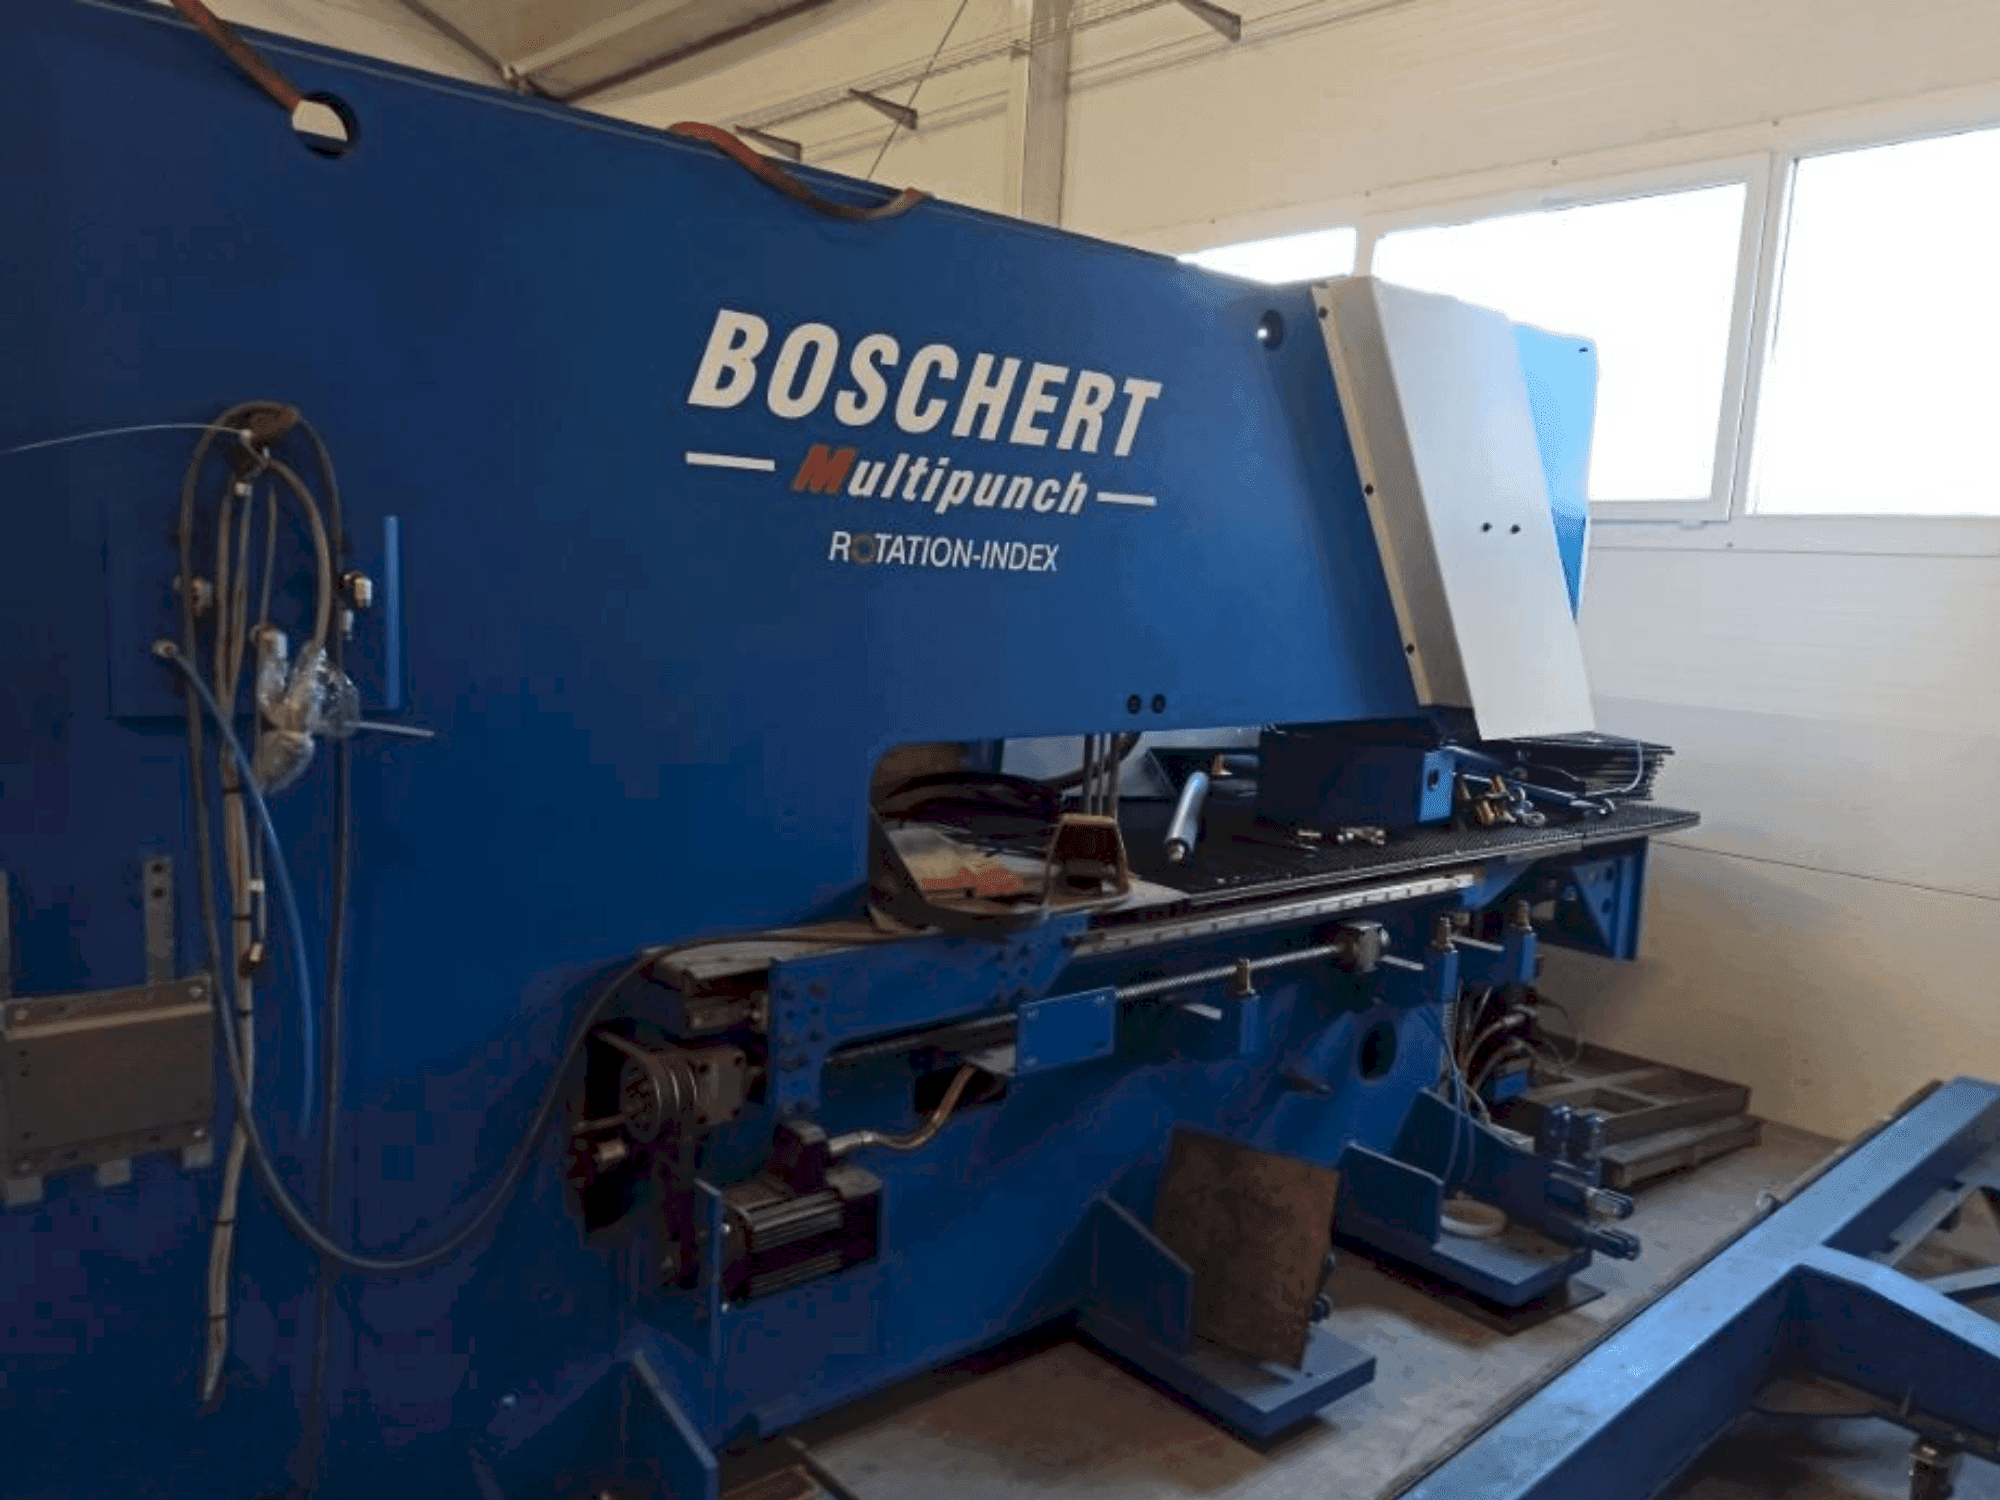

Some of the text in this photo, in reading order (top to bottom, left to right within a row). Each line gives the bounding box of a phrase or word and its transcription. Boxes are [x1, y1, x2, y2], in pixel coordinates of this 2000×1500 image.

[687, 309, 1163, 457] BOSCHERT
[792, 444, 1088, 514] Multipunch
[828, 531, 1058, 572] ROTATION-INDEX
